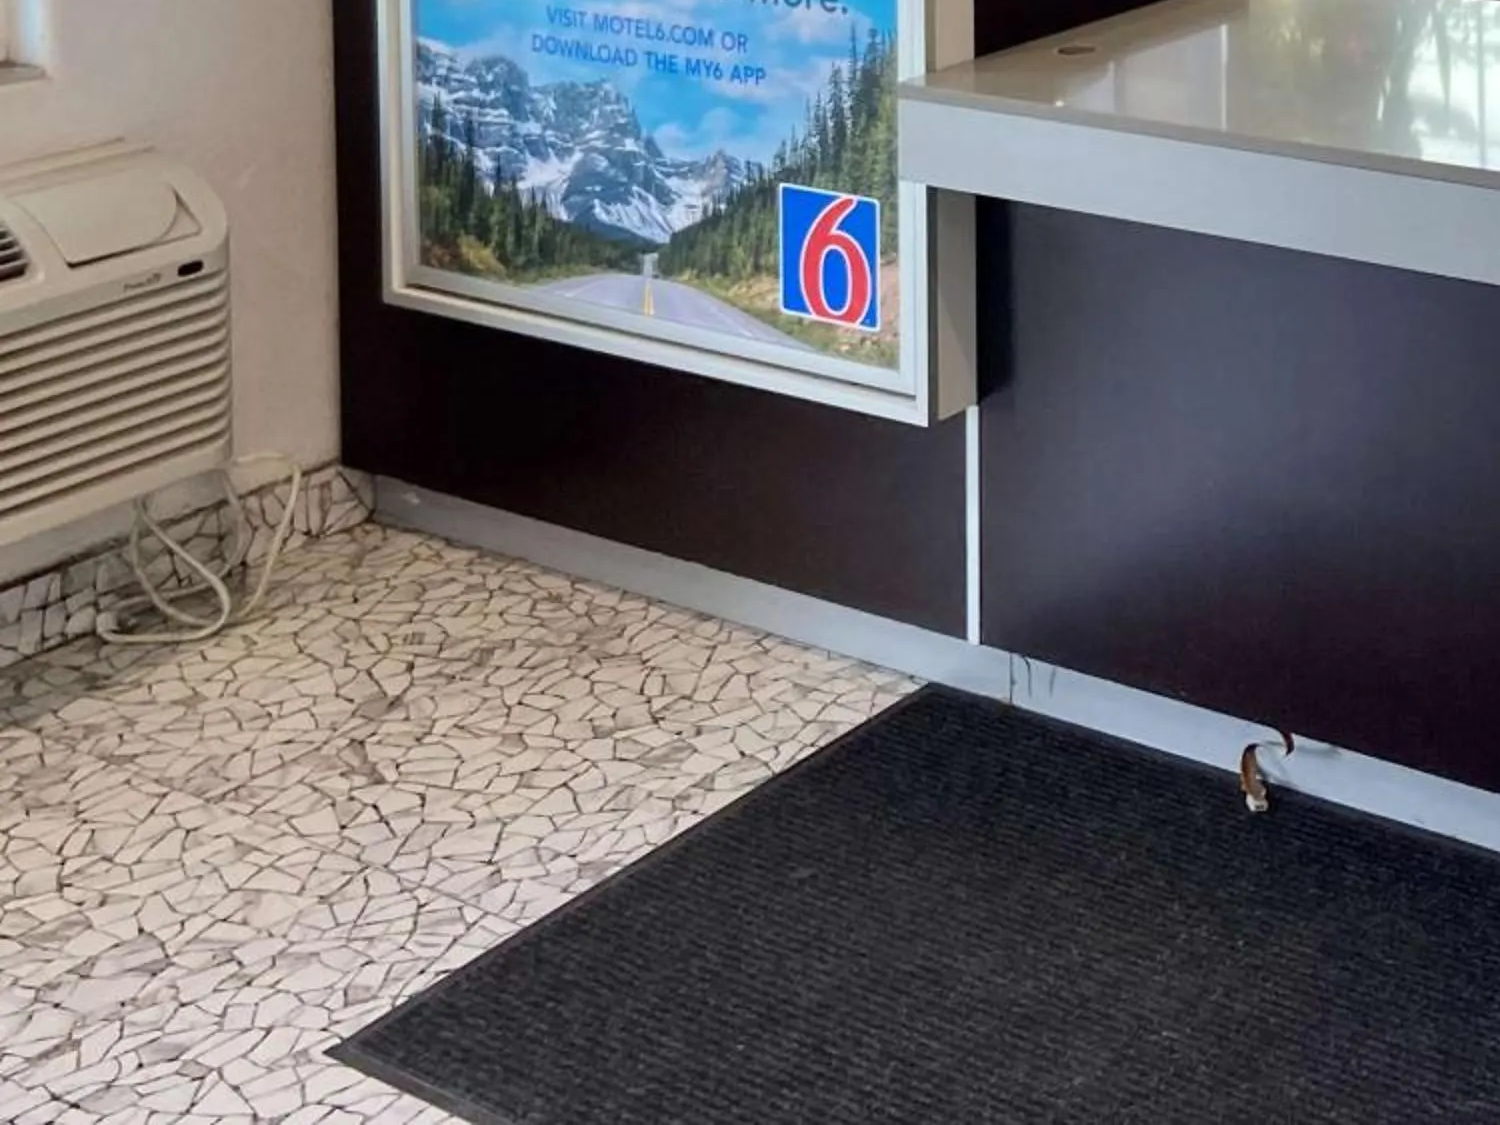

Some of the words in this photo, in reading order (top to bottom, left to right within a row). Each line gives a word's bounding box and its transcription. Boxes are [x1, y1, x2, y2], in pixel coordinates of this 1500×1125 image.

[546, 6, 587, 28] VISIT
[593, 14, 714, 47] MOTEL6.COM
[722, 32, 749, 53] OR
[532, 34, 638, 68] DOWNLOAD
[644, 51, 678, 73] THE
[686, 58, 723, 81] MY6
[730, 66, 767, 87] APP
[799, 195, 873, 324] 6
